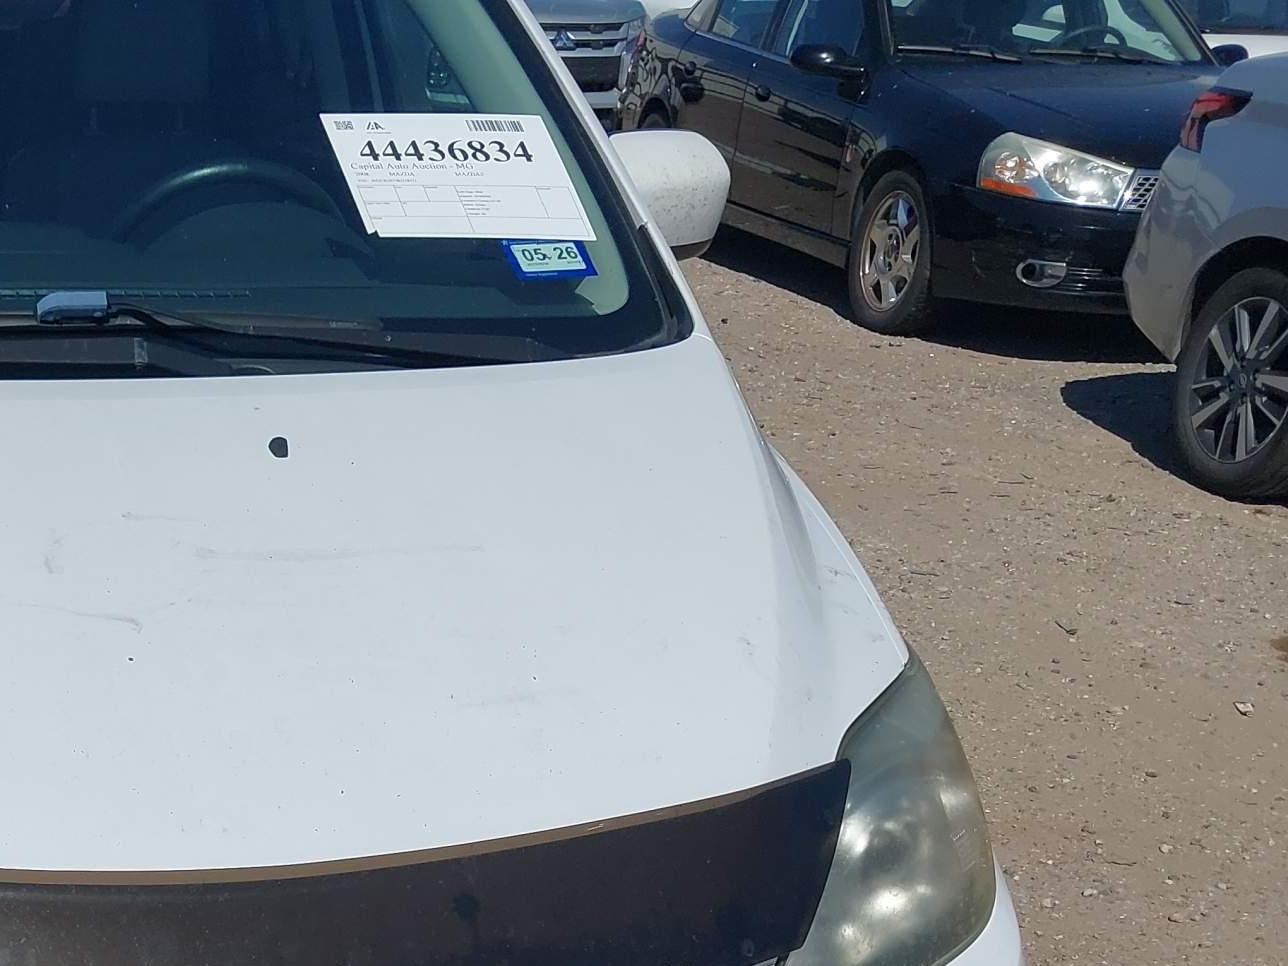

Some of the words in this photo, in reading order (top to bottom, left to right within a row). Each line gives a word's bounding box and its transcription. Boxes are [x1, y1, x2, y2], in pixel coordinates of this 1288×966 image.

[360, 139, 534, 162] 44436834
[351, 162, 384, 171] Capital
[387, 162, 409, 170] Auto
[412, 162, 447, 170] Auction
[455, 162, 474, 170] MG
[521, 248, 546, 261] 05
[553, 246, 578, 260] 26
